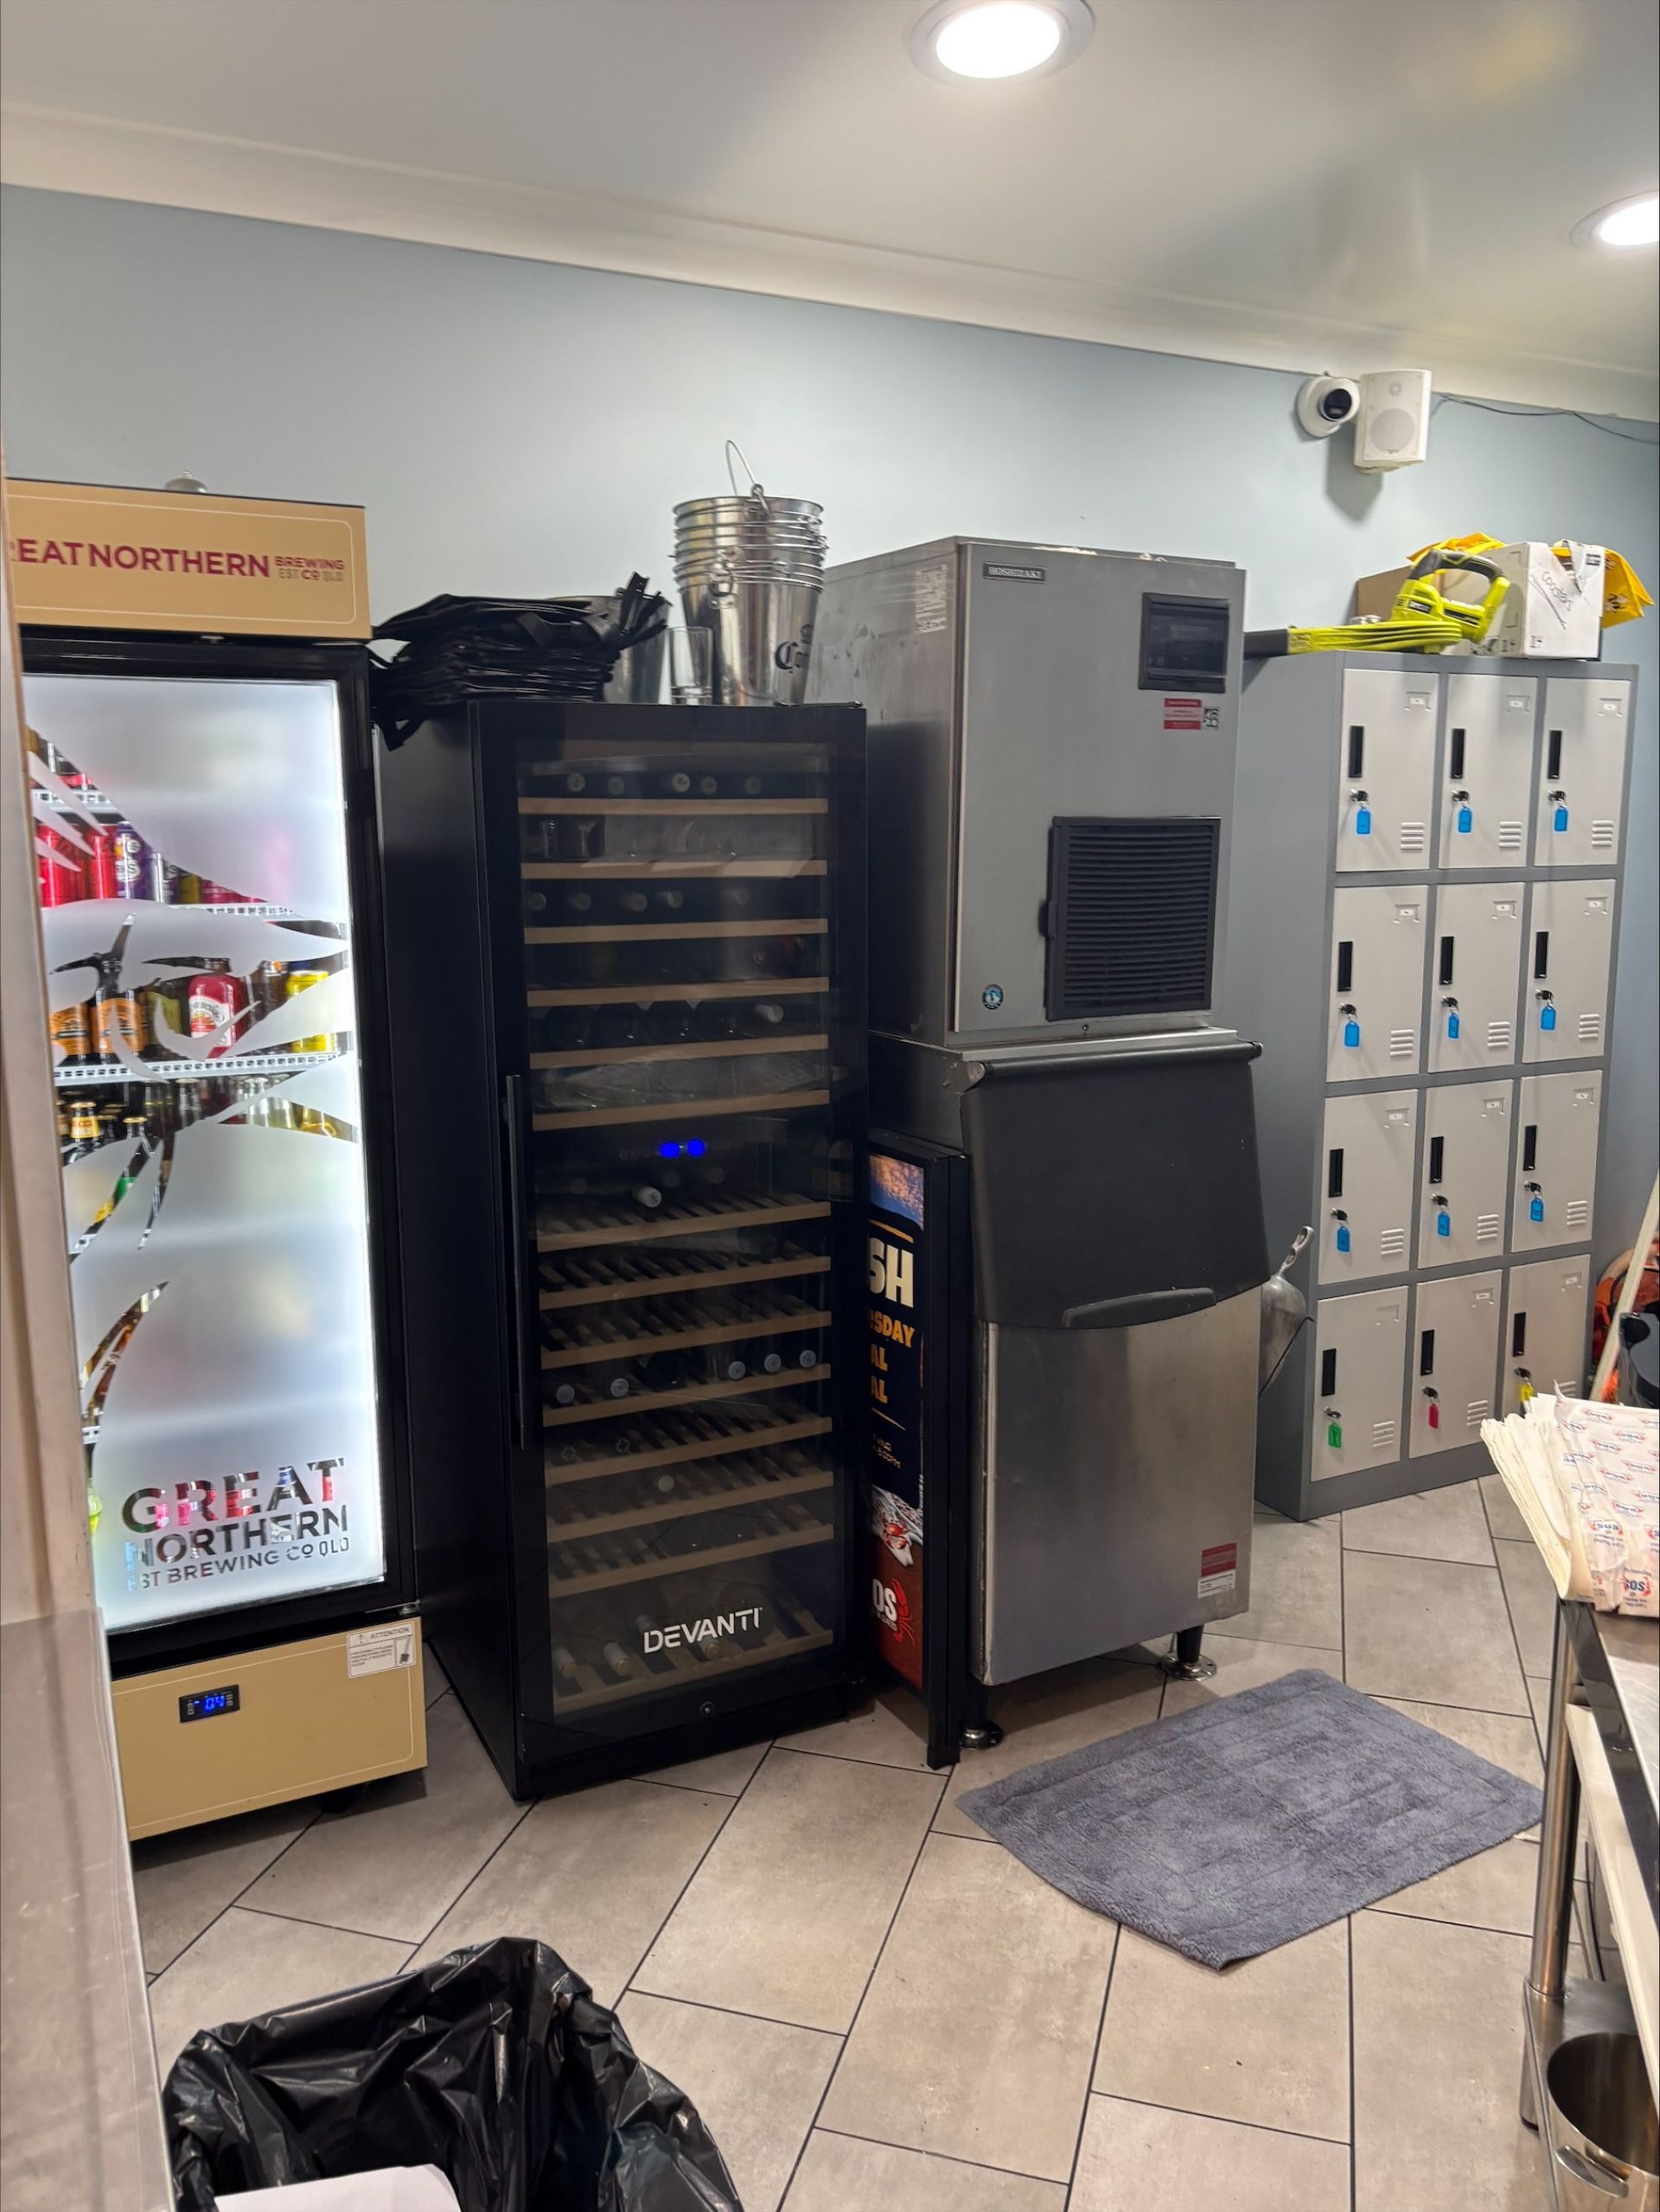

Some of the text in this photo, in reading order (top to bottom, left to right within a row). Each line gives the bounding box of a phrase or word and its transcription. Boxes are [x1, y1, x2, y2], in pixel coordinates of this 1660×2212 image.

[87, 543, 271, 579] NORTHERN
[274, 556, 346, 571] BREWING
[122, 1457, 345, 1533] GREAT
[124, 1505, 348, 1571] NORTHERN
[126, 1570, 162, 1591] EST
[167, 1550, 280, 1584] BREWING
[319, 1538, 349, 1557] QLD
[643, 1606, 763, 1653] DEVANTI
